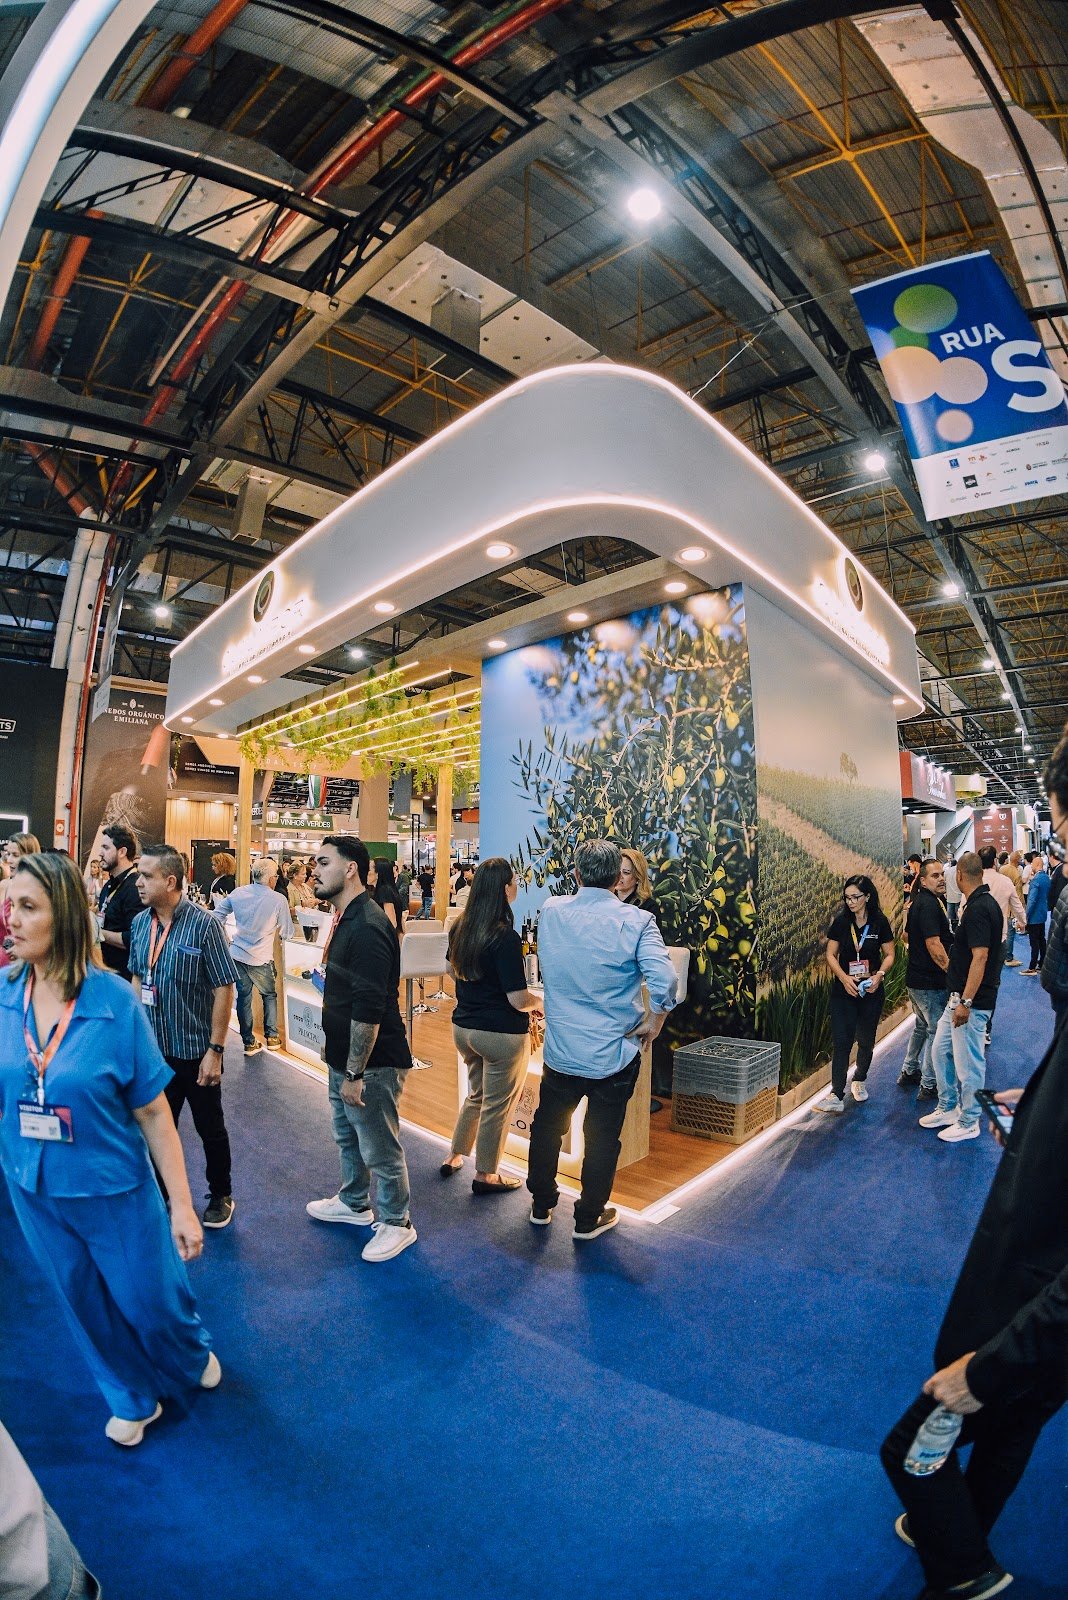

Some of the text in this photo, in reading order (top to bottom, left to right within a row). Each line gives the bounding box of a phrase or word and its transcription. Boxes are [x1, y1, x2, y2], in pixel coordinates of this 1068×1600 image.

[940, 322, 1005, 354] RUA
[991, 340, 1065, 413] S
[114, 716, 149, 725] EMILIANA
[280, 818, 331, 828] VINHOS VERDES
